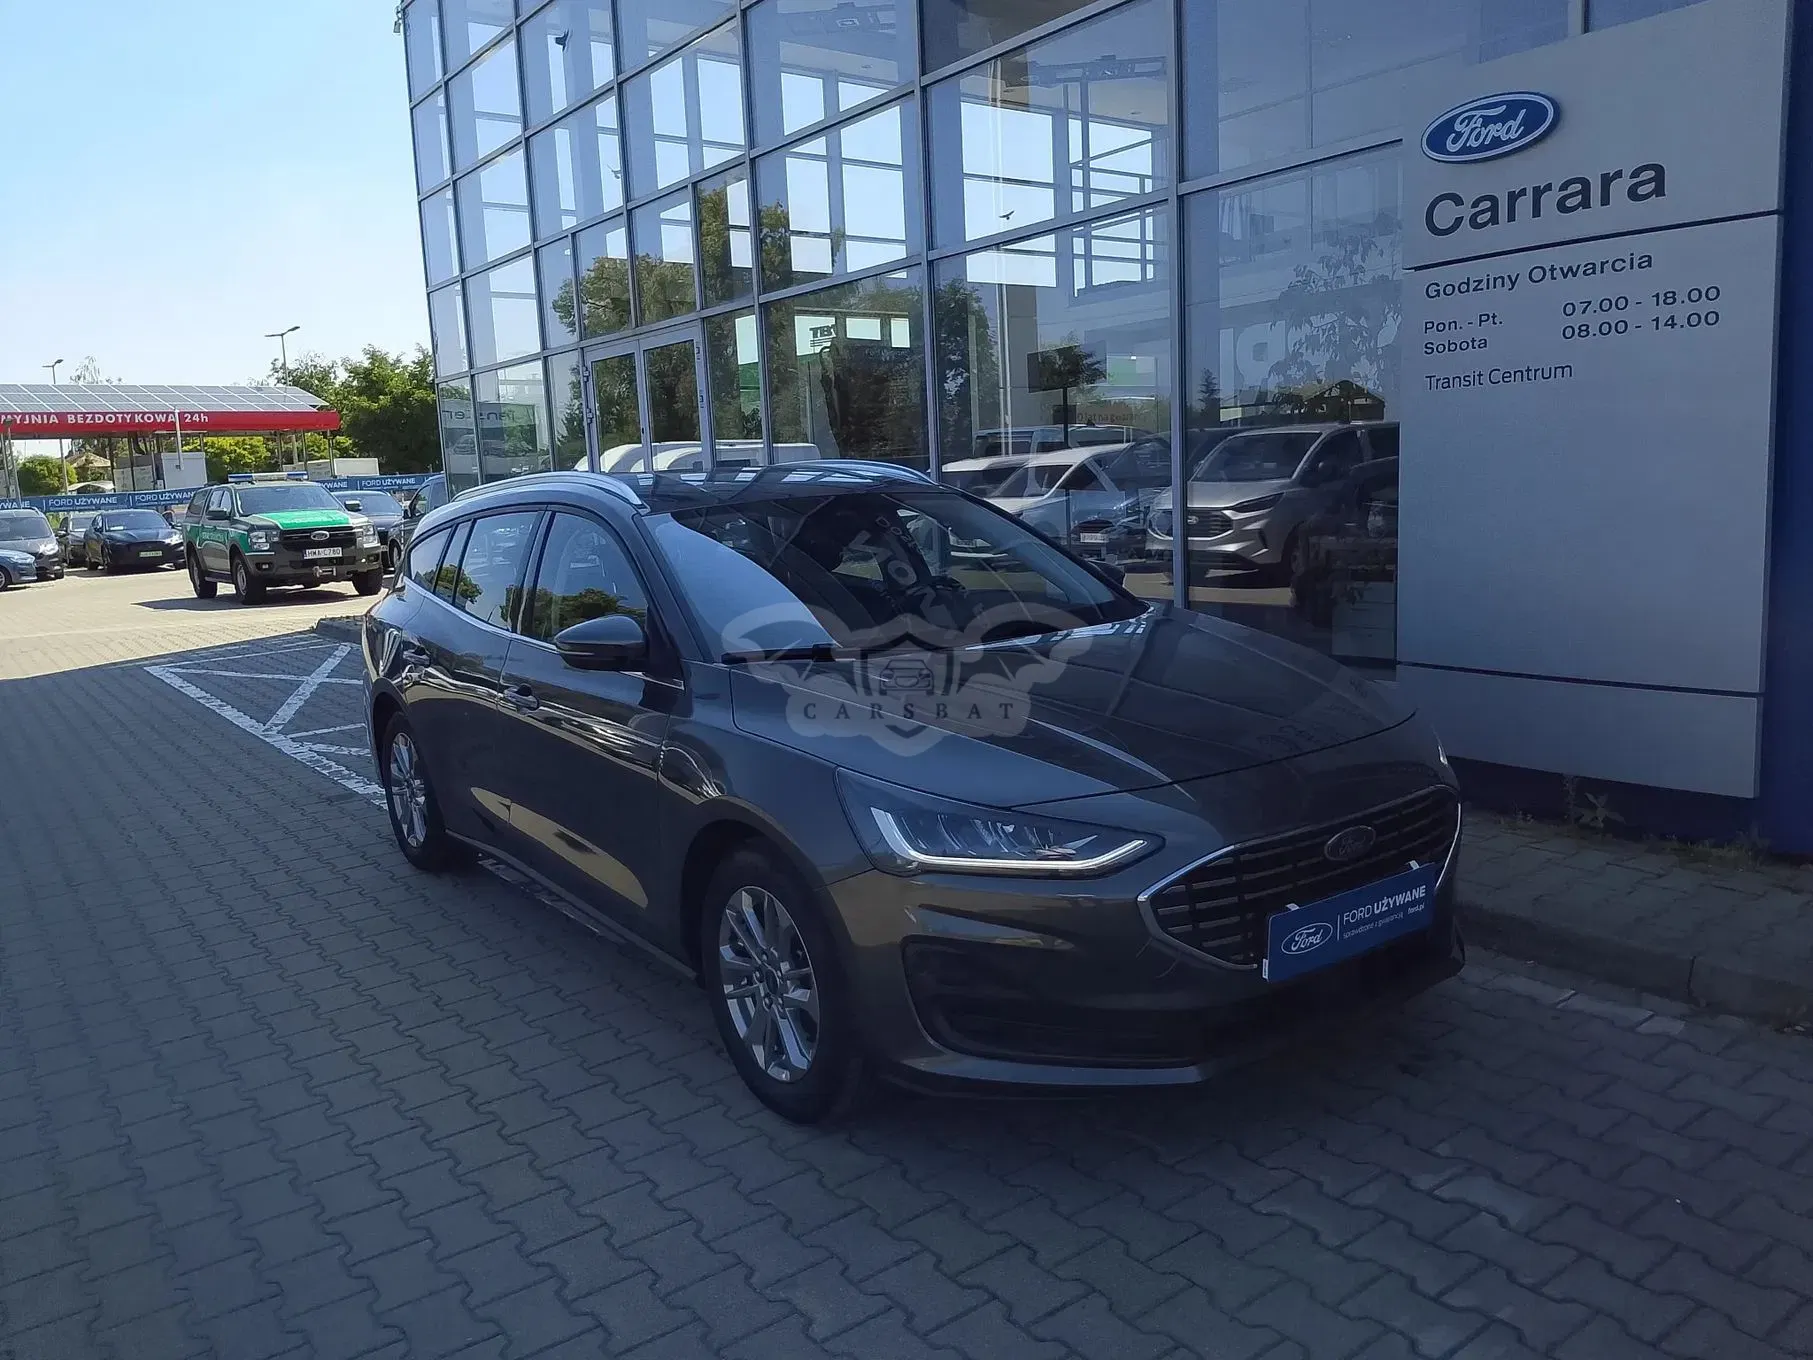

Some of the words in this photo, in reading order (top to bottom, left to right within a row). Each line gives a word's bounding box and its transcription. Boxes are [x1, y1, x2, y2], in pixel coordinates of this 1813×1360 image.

[1446, 104, 1526, 153] Ford
[1424, 162, 1667, 237] Carrara
[1425, 272, 1520, 299] Godziny
[1528, 252, 1653, 284] Otwarcia
[1424, 319, 1463, 334] Pon.
[1478, 312, 1503, 328] Pt.
[1562, 295, 1629, 317] 07.00
[1651, 285, 1721, 307] 18.00
[1424, 337, 1488, 355] Sobota
[1562, 319, 1629, 340] 08.00
[1651, 310, 1720, 331] 14.00
[1425, 370, 1484, 391] Transit
[1488, 364, 1573, 385] Centrum
[67, 413, 177, 424] BEZDOTYKOWA
[184, 413, 209, 423] 24h
[49, 498, 73, 507] FORD
[74, 496, 118, 506] UŻYWANE
[135, 494, 158, 502] FORD
[1343, 905, 1372, 925] FORD
[1374, 885, 1426, 914] UŻYWANE
[1291, 927, 1324, 951] Ford
